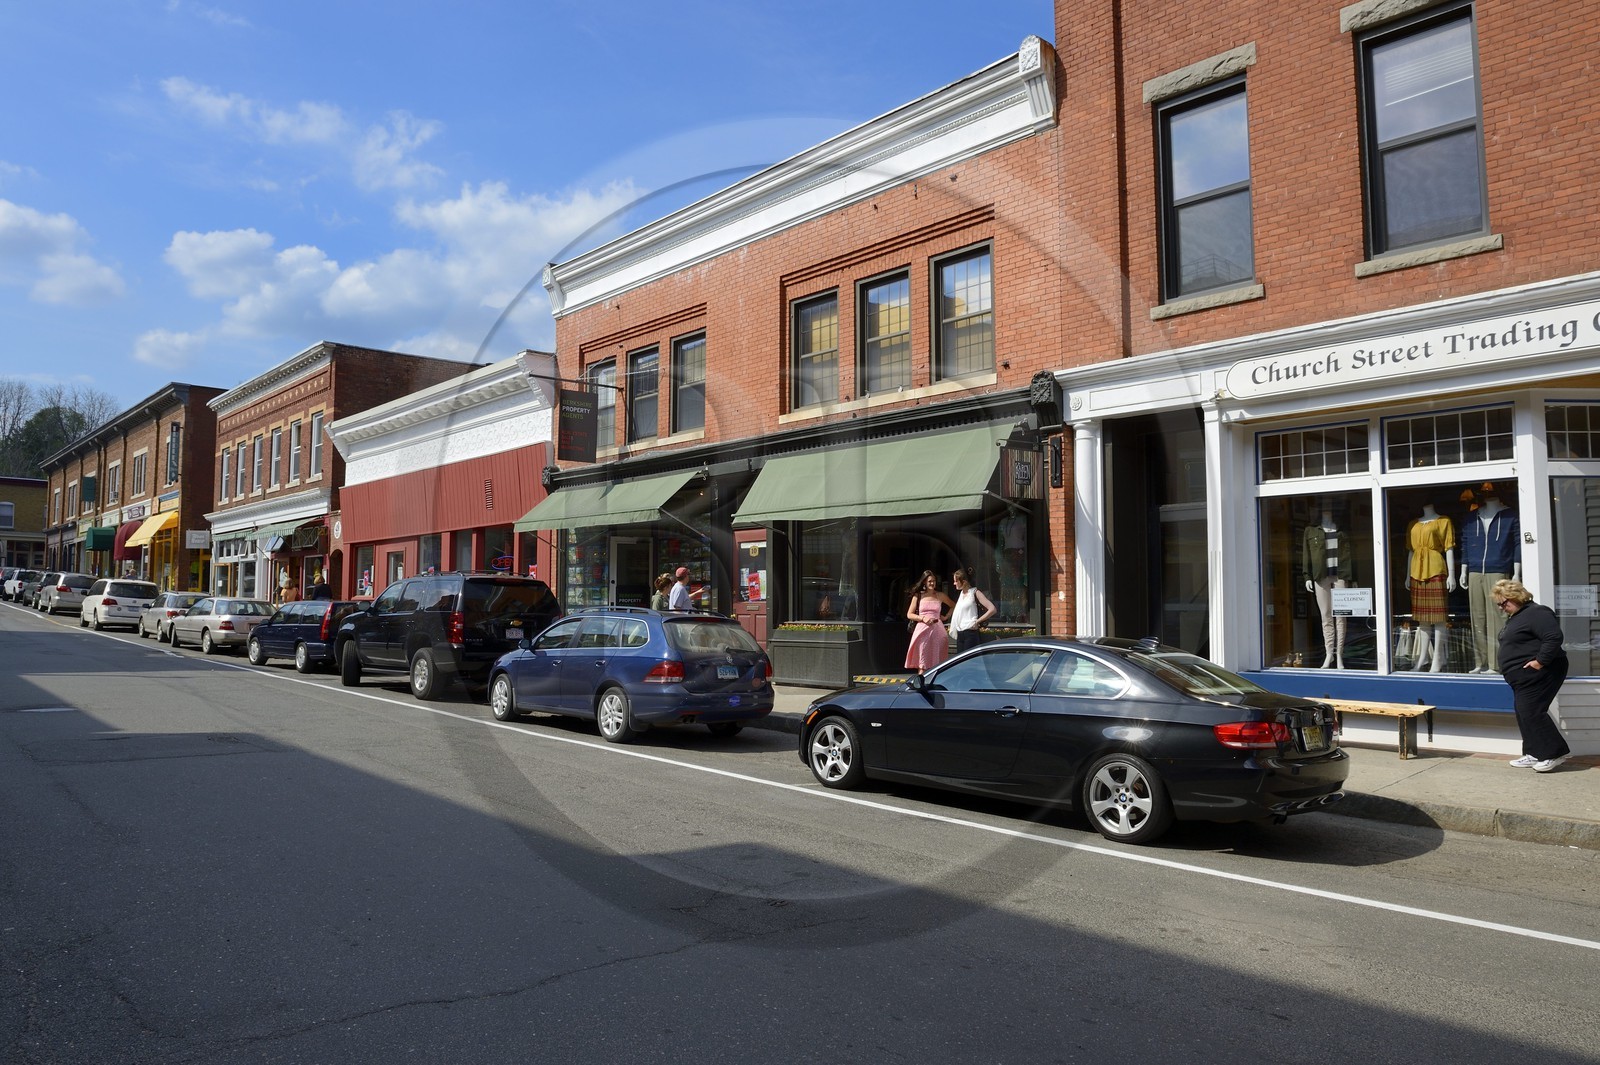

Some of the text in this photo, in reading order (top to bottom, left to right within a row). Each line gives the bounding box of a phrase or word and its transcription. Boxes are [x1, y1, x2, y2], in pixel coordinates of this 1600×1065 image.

[1251, 351, 1341, 385] Church
[1352, 341, 1435, 370] Street
[1443, 319, 1579, 356] Trading
[562, 400, 592, 408] BERKSHIRE
[561, 406, 591, 414] PROPERTY
